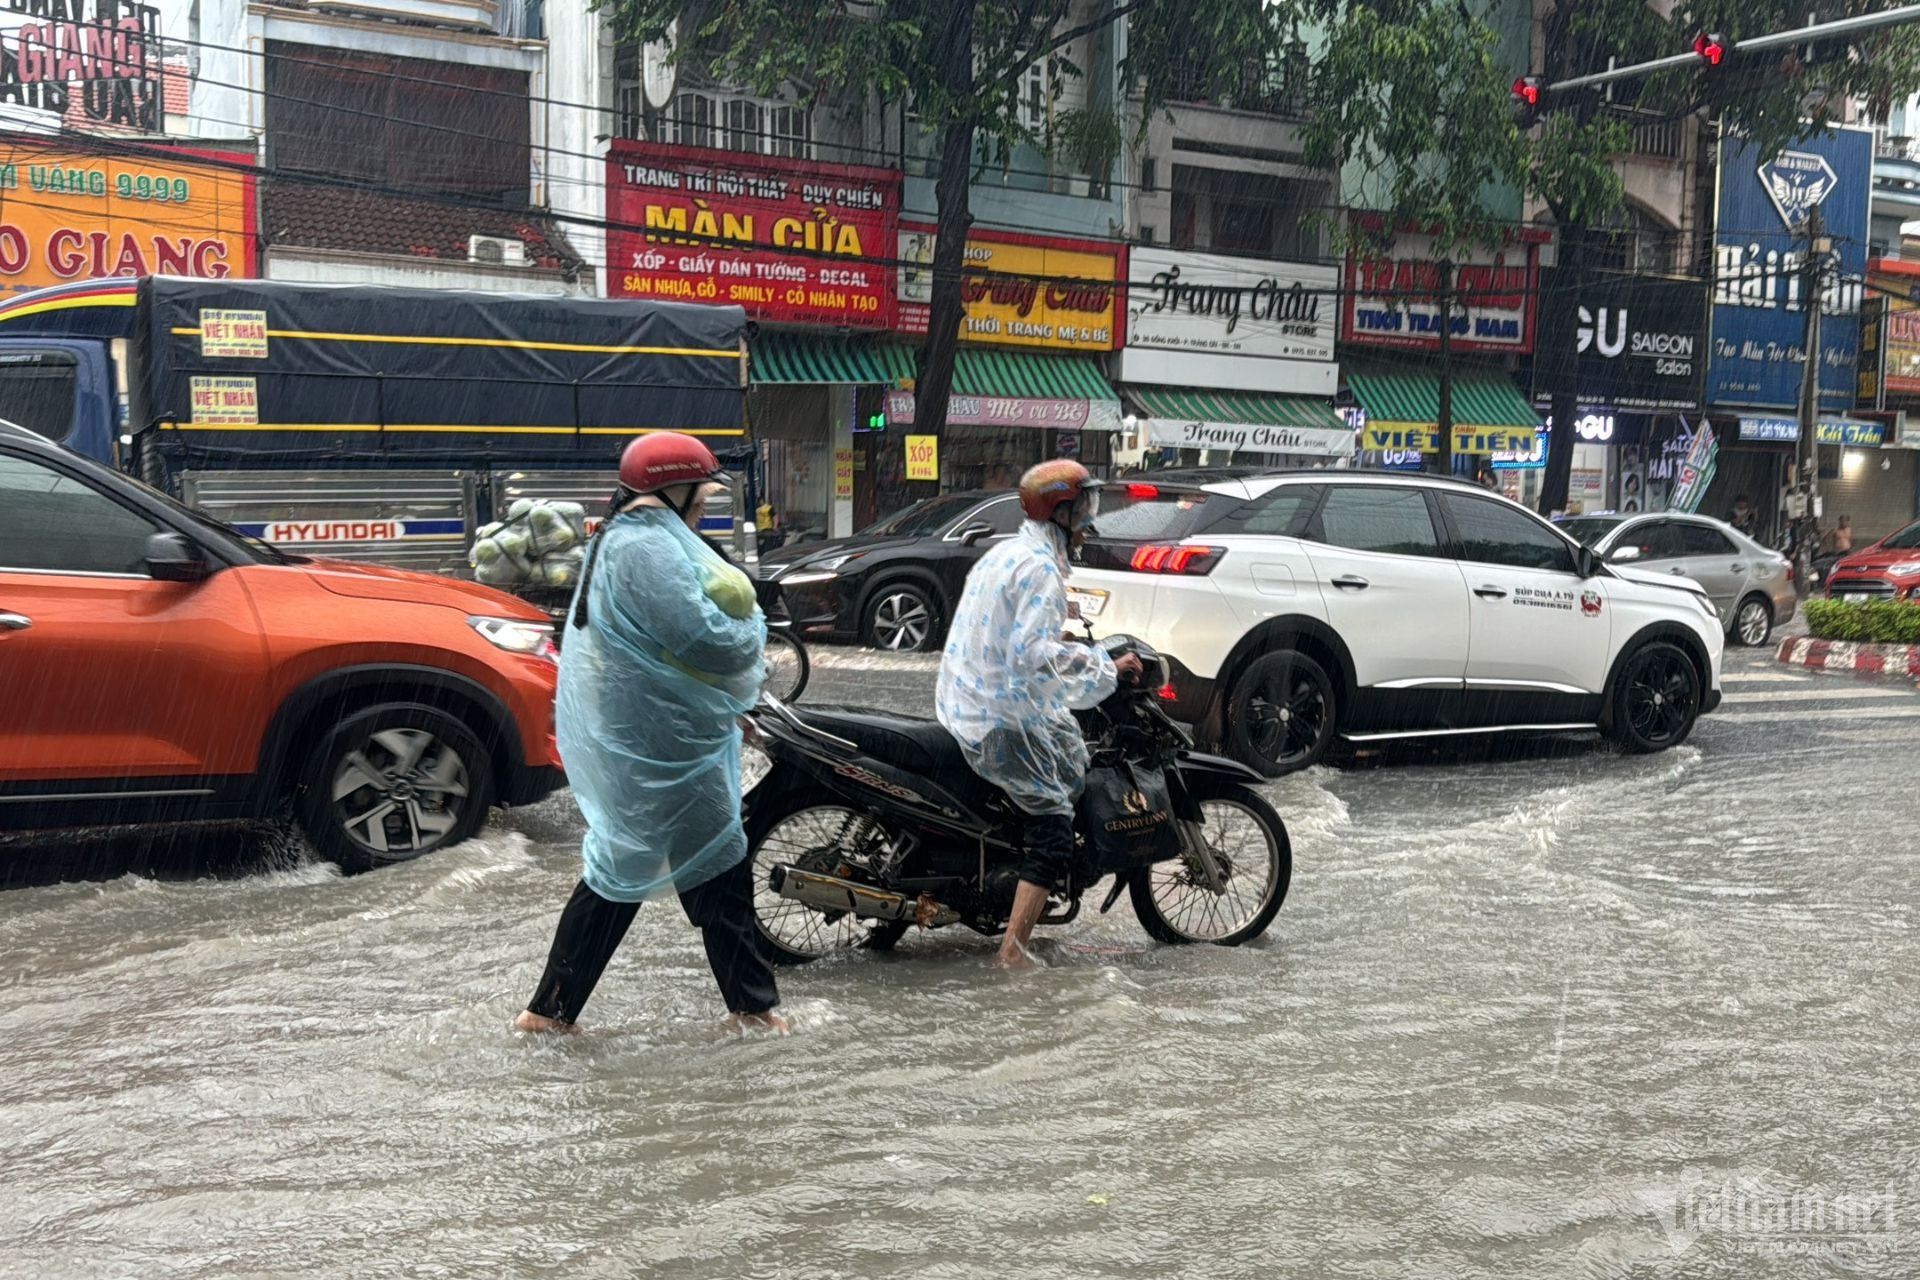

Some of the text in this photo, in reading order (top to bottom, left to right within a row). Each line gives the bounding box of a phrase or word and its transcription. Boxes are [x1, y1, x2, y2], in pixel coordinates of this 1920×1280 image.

[18, 16, 143, 83] GIANG
[29, 163, 106, 196] VÀNG
[117, 174, 189, 201] 9999
[624, 165, 680, 189] TRANG
[686, 173, 712, 191] TRÍ
[645, 199, 864, 256] MÀN CỬA
[47, 229, 231, 281] GIANG
[632, 248, 667, 270] XỐP
[678, 252, 716, 274] GIẤY
[719, 257, 751, 278] DÁN
[819, 269, 870, 288] DECAL
[963, 246, 993, 261] HOP
[623, 272, 652, 293] SÀN
[729, 284, 776, 303] SIMILY
[786, 286, 806, 306] CỎ
[809, 288, 847, 309] NHÂN
[851, 294, 879, 313] TẠO
[1362, 253, 1441, 305] TRAN
[1714, 242, 1862, 315] Hải Tần
[1151, 264, 1320, 335] Trang Châu
[966, 313, 1111, 345] THỜI TRANG MẸ & BÉ
[1475, 317, 1520, 340] NAM
[1631, 331, 1693, 354] SAIGON
[1655, 358, 1692, 376] Salon
[890, 397, 916, 414] TRA
[947, 396, 980, 416] HÂU
[1183, 421, 1246, 451] Trang
[1252, 428, 1302, 448] Châu
[1454, 430, 1531, 451] TIẾN
[273, 522, 398, 542] HYUNDAI
